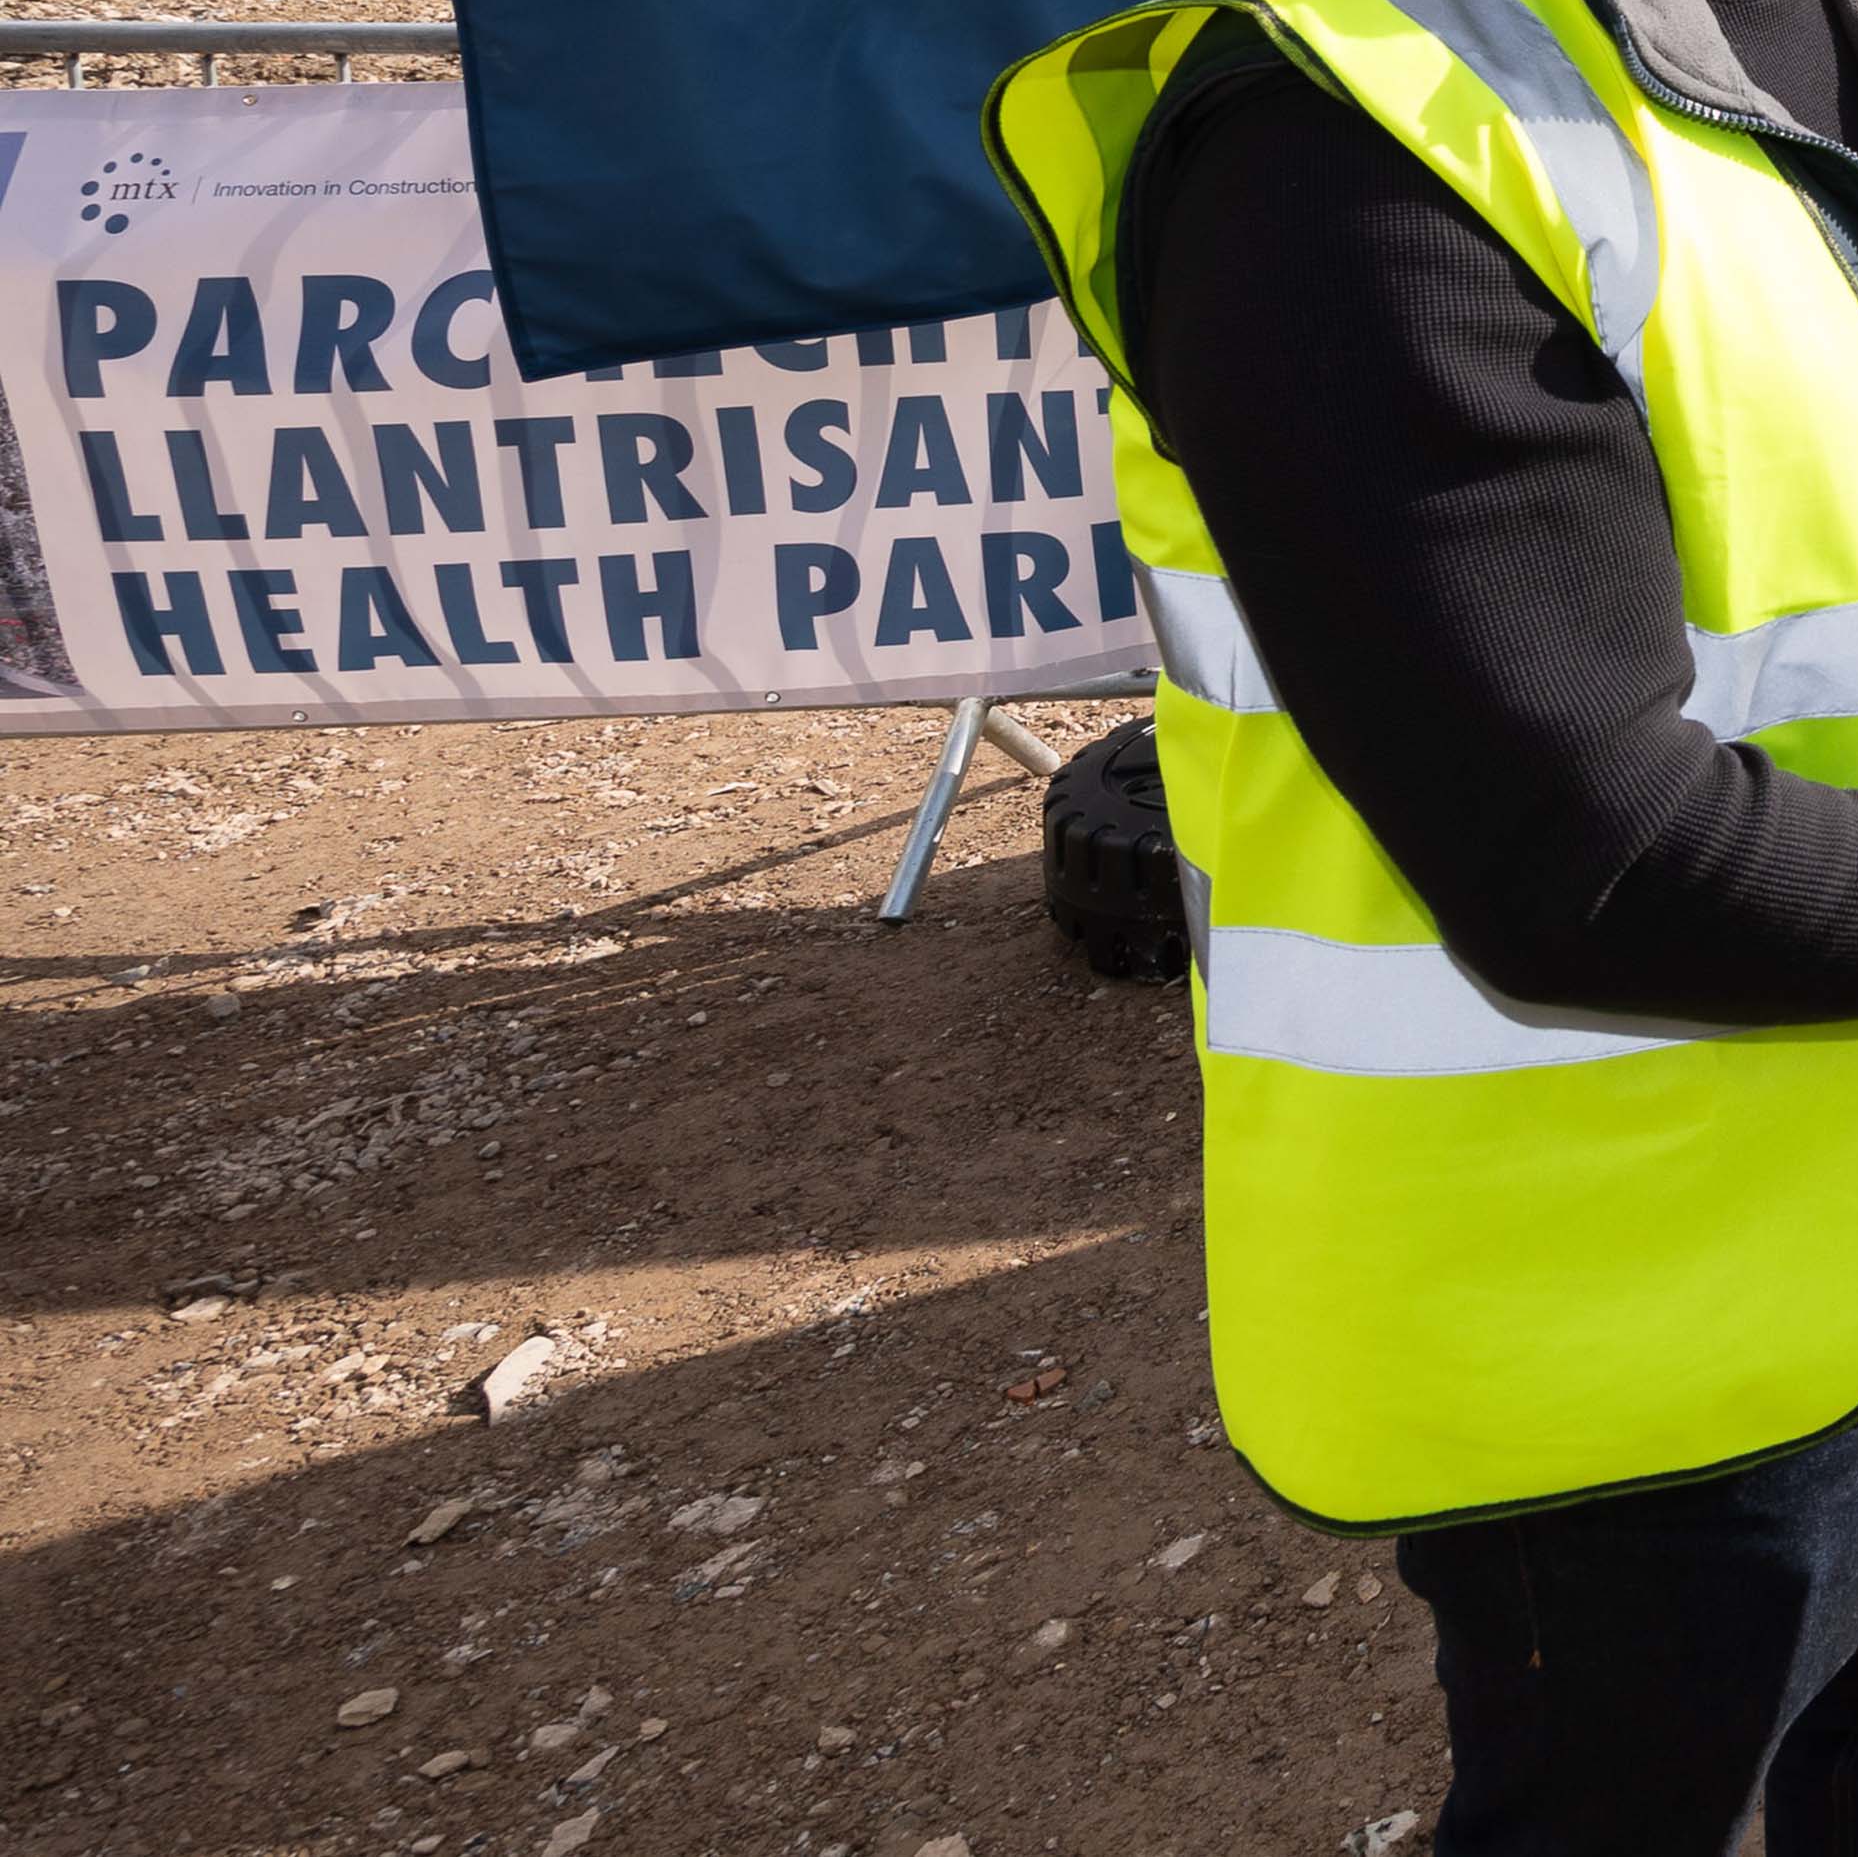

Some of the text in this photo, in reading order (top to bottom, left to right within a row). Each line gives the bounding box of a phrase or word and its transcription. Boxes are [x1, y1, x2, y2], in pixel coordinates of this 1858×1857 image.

[110, 179, 178, 200] mtx
[213, 182, 316, 198] Innovation
[324, 181, 341, 196] in
[56, 269, 496, 399] PARC
[78, 388, 1112, 543] LLANTRISAN
[112, 550, 702, 676] HEALTH
